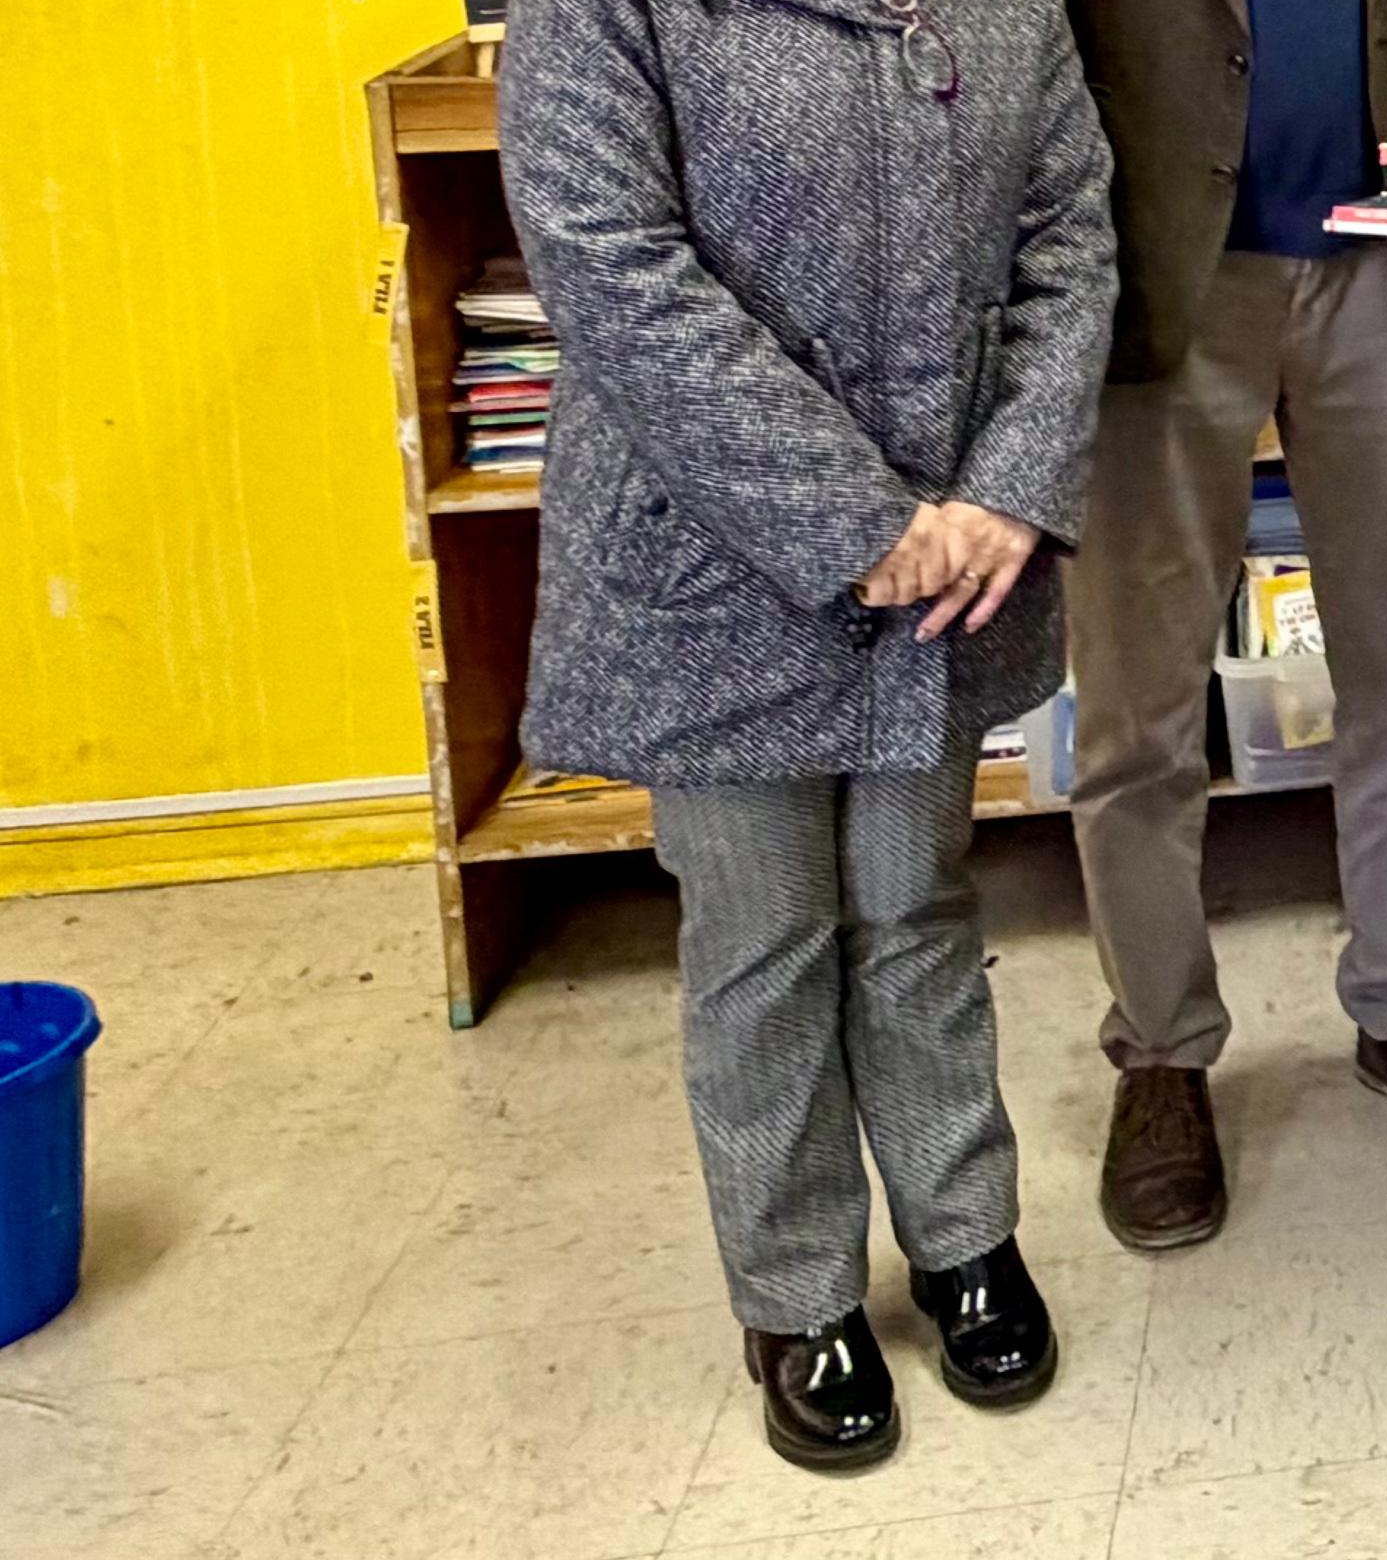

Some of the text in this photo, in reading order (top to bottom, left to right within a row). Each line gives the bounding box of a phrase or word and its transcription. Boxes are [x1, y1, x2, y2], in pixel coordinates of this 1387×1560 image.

[373, 260, 395, 315] FILA 1
[415, 595, 435, 649] FILA 2
